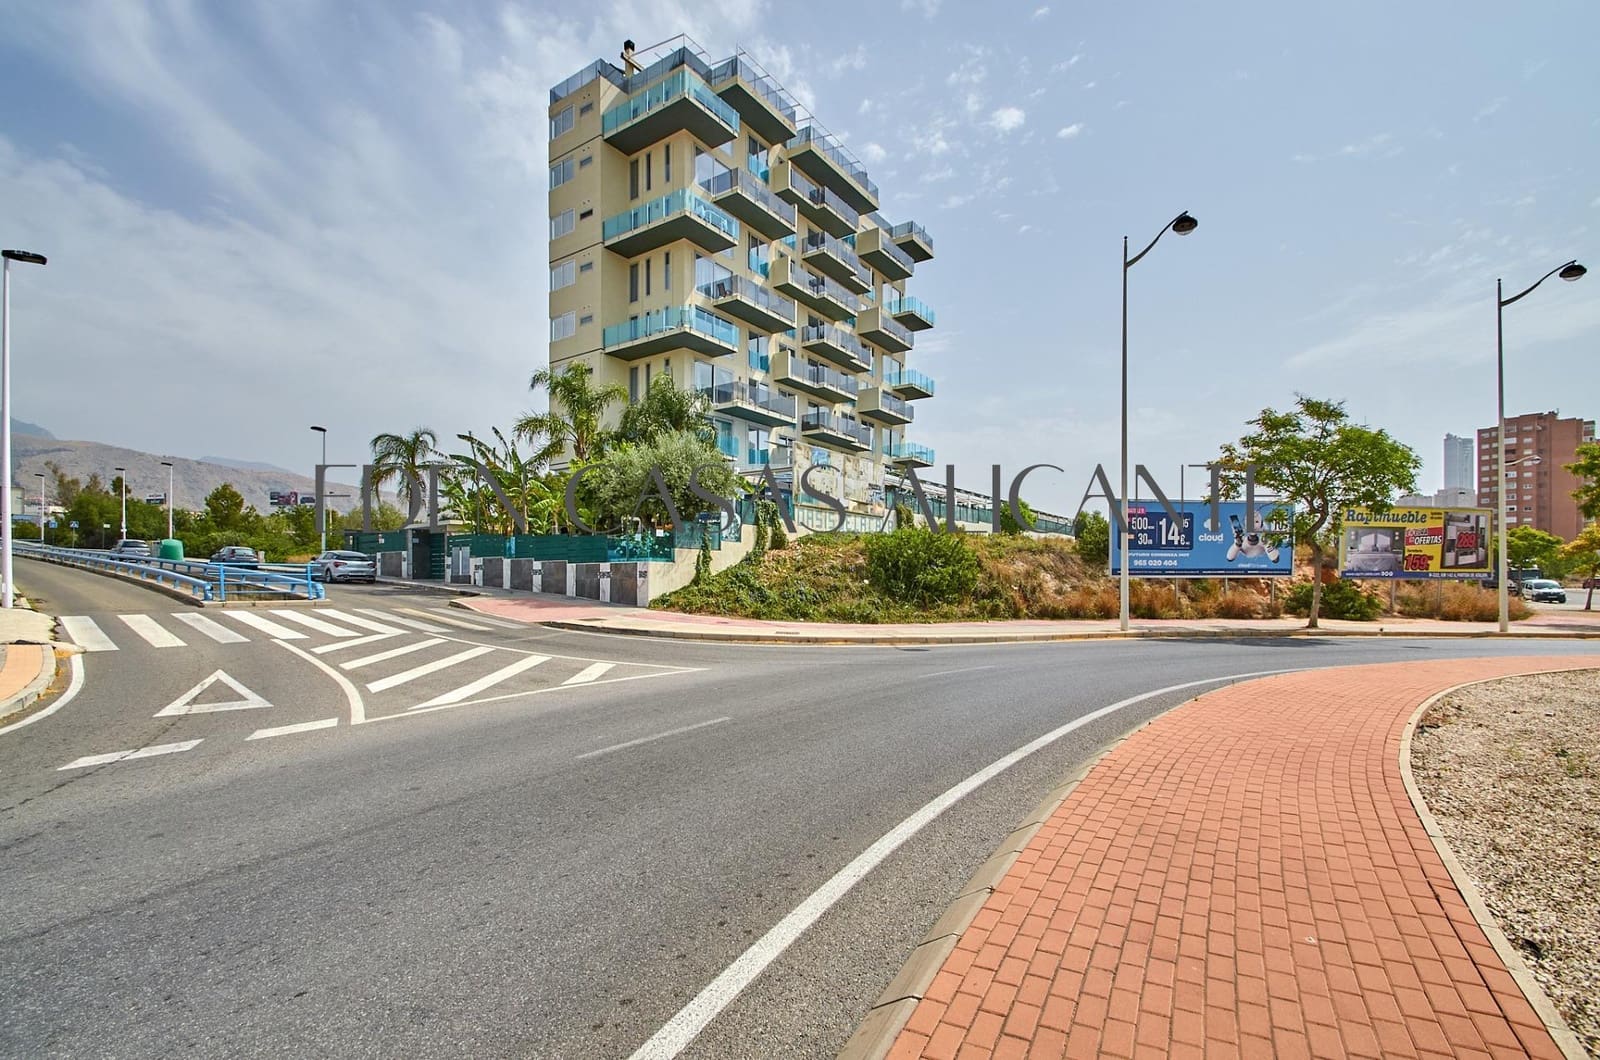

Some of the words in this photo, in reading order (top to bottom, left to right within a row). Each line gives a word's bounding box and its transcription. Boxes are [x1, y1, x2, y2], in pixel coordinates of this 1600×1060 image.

[1159, 518, 1180, 545] 14
[1199, 533, 1224, 542] cloud
[1414, 535, 1442, 545] OFERTAS
